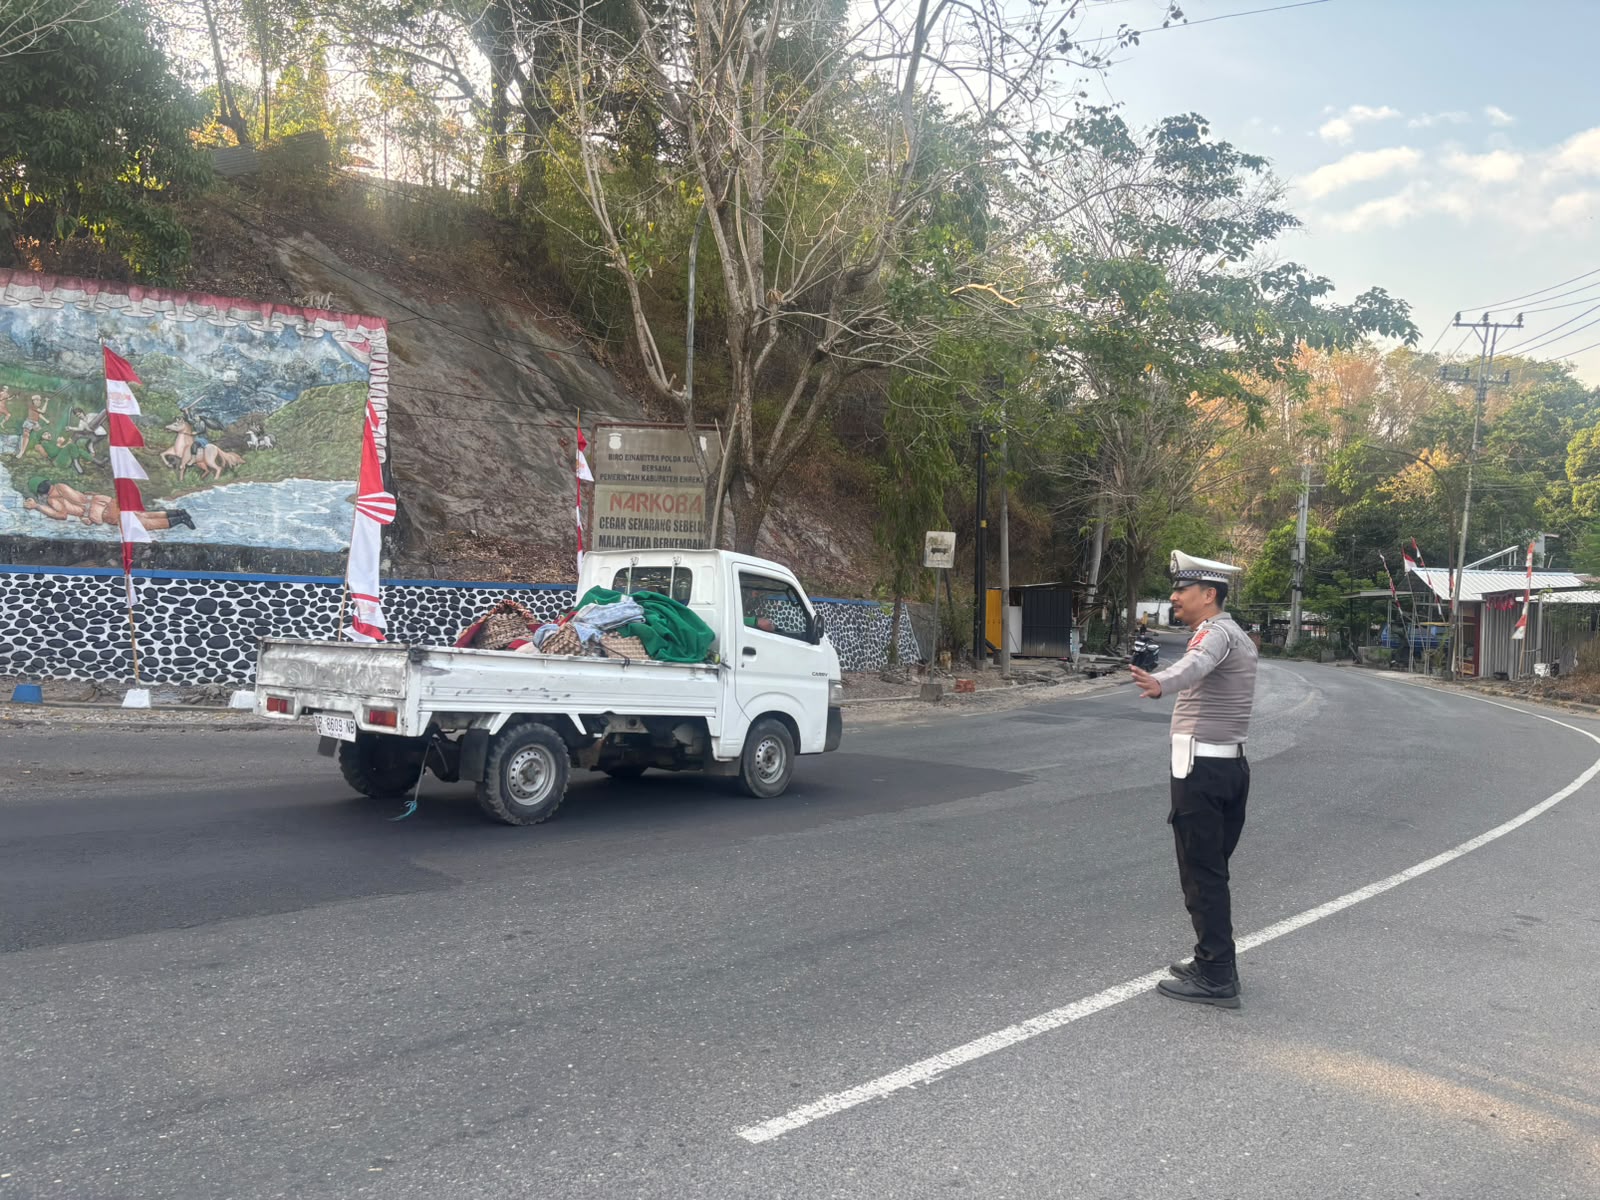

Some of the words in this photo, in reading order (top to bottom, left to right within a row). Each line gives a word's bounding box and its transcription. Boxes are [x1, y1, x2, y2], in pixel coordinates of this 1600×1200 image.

[608, 453, 624, 461] BIRO
[661, 455, 681, 463] POLDA
[641, 464, 672, 472] BERSAMA
[641, 474, 679, 482] KABUPATEN
[610, 492, 703, 513] NARKOBA
[599, 516, 626, 530] CEGAH
[628, 517, 672, 532] SEKARANG
[673, 520, 707, 533] SEBELU
[599, 534, 651, 549] MALAPETAKA
[653, 537, 706, 549] BERKEMBAN
[378, 687, 400, 696] CARRY
[327, 717, 343, 732] 8609
[346, 720, 354, 734] NB
